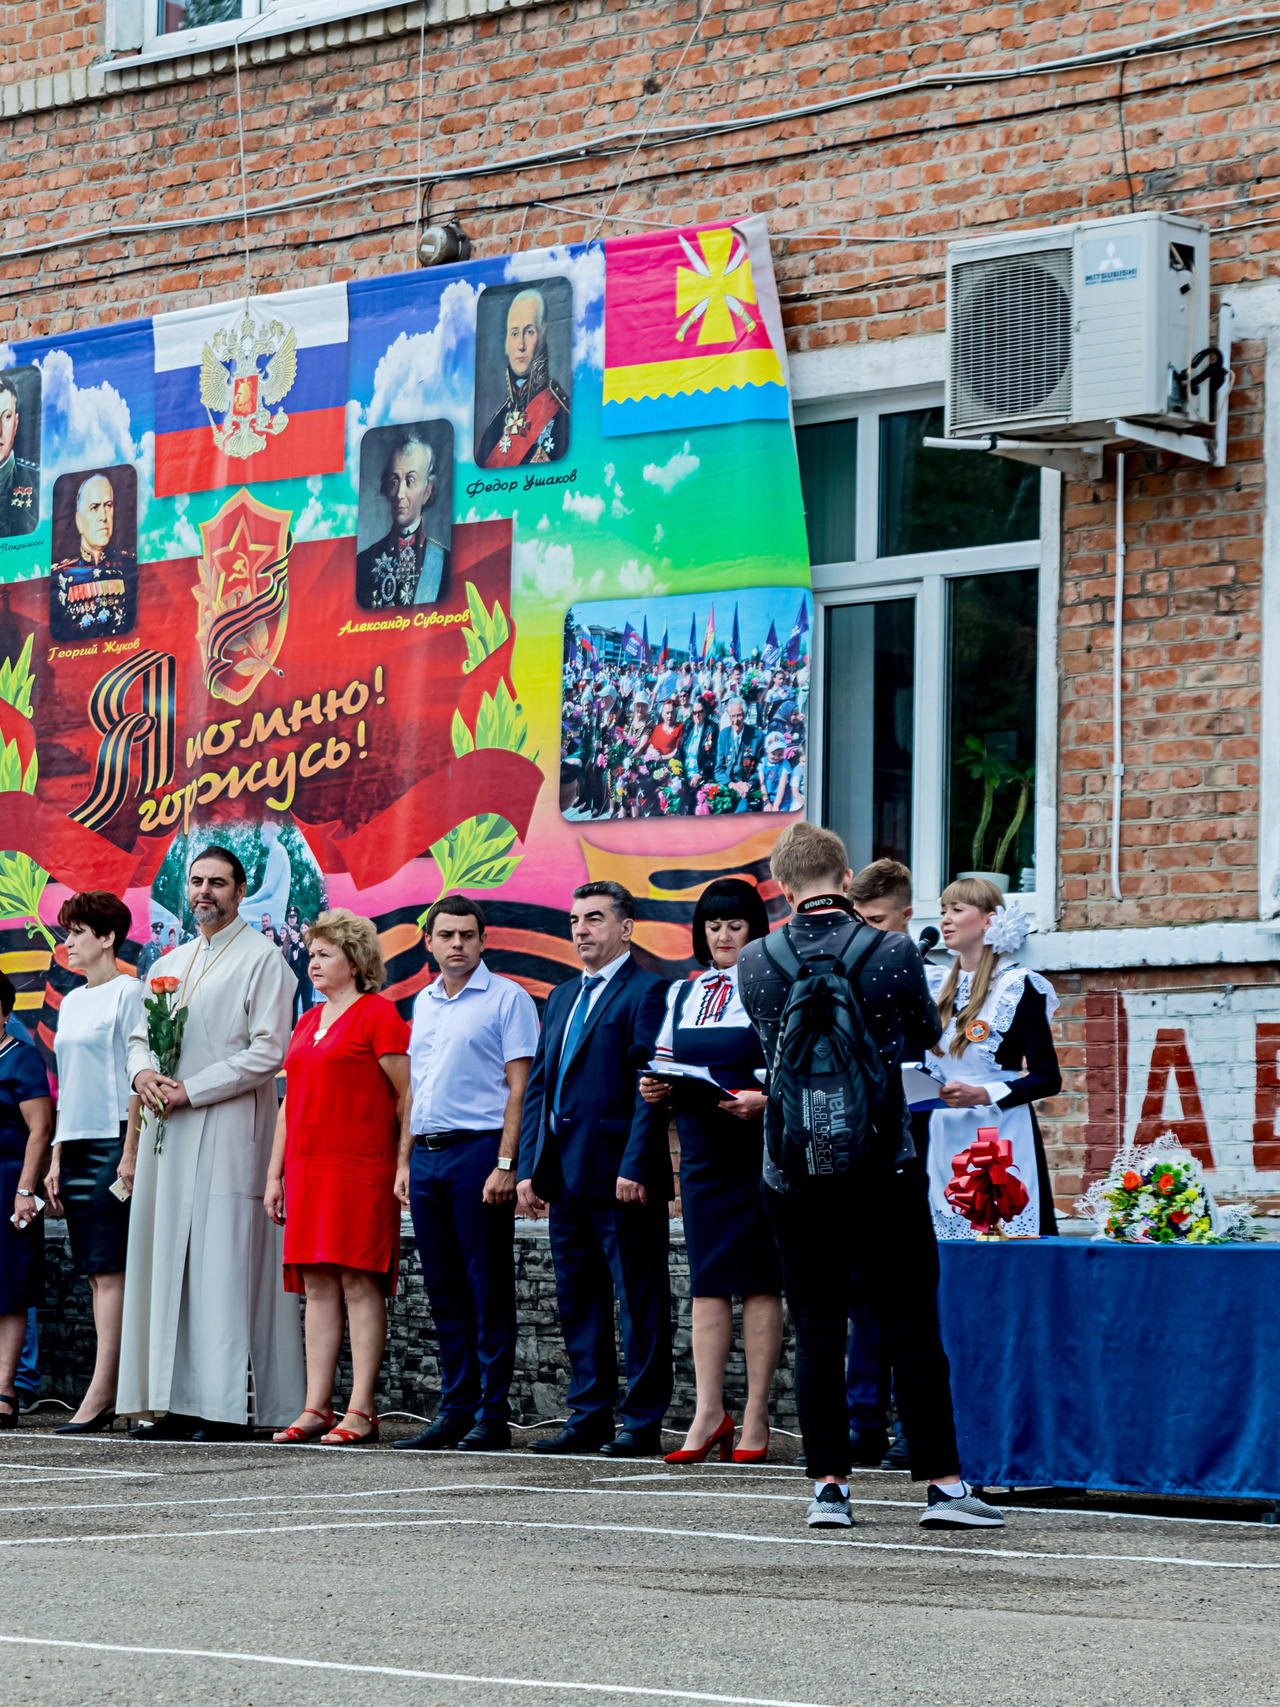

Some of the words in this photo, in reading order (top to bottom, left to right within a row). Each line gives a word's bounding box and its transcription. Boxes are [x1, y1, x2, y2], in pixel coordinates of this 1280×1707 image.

[1085, 268, 1138, 282] MITSUBISHI
[466, 478, 519, 498] Федор
[522, 468, 578, 491] Ушаков
[0, 539, 45, 554] Покрышкин
[337, 615, 411, 637] Александр
[413, 608, 471, 628] Суворов
[47, 644, 99, 662] Георгий
[101, 637, 141, 655] Жуков
[67, 649, 177, 834] Я
[137, 719, 369, 836] горжусь!
[804, 897, 834, 910] Canon
